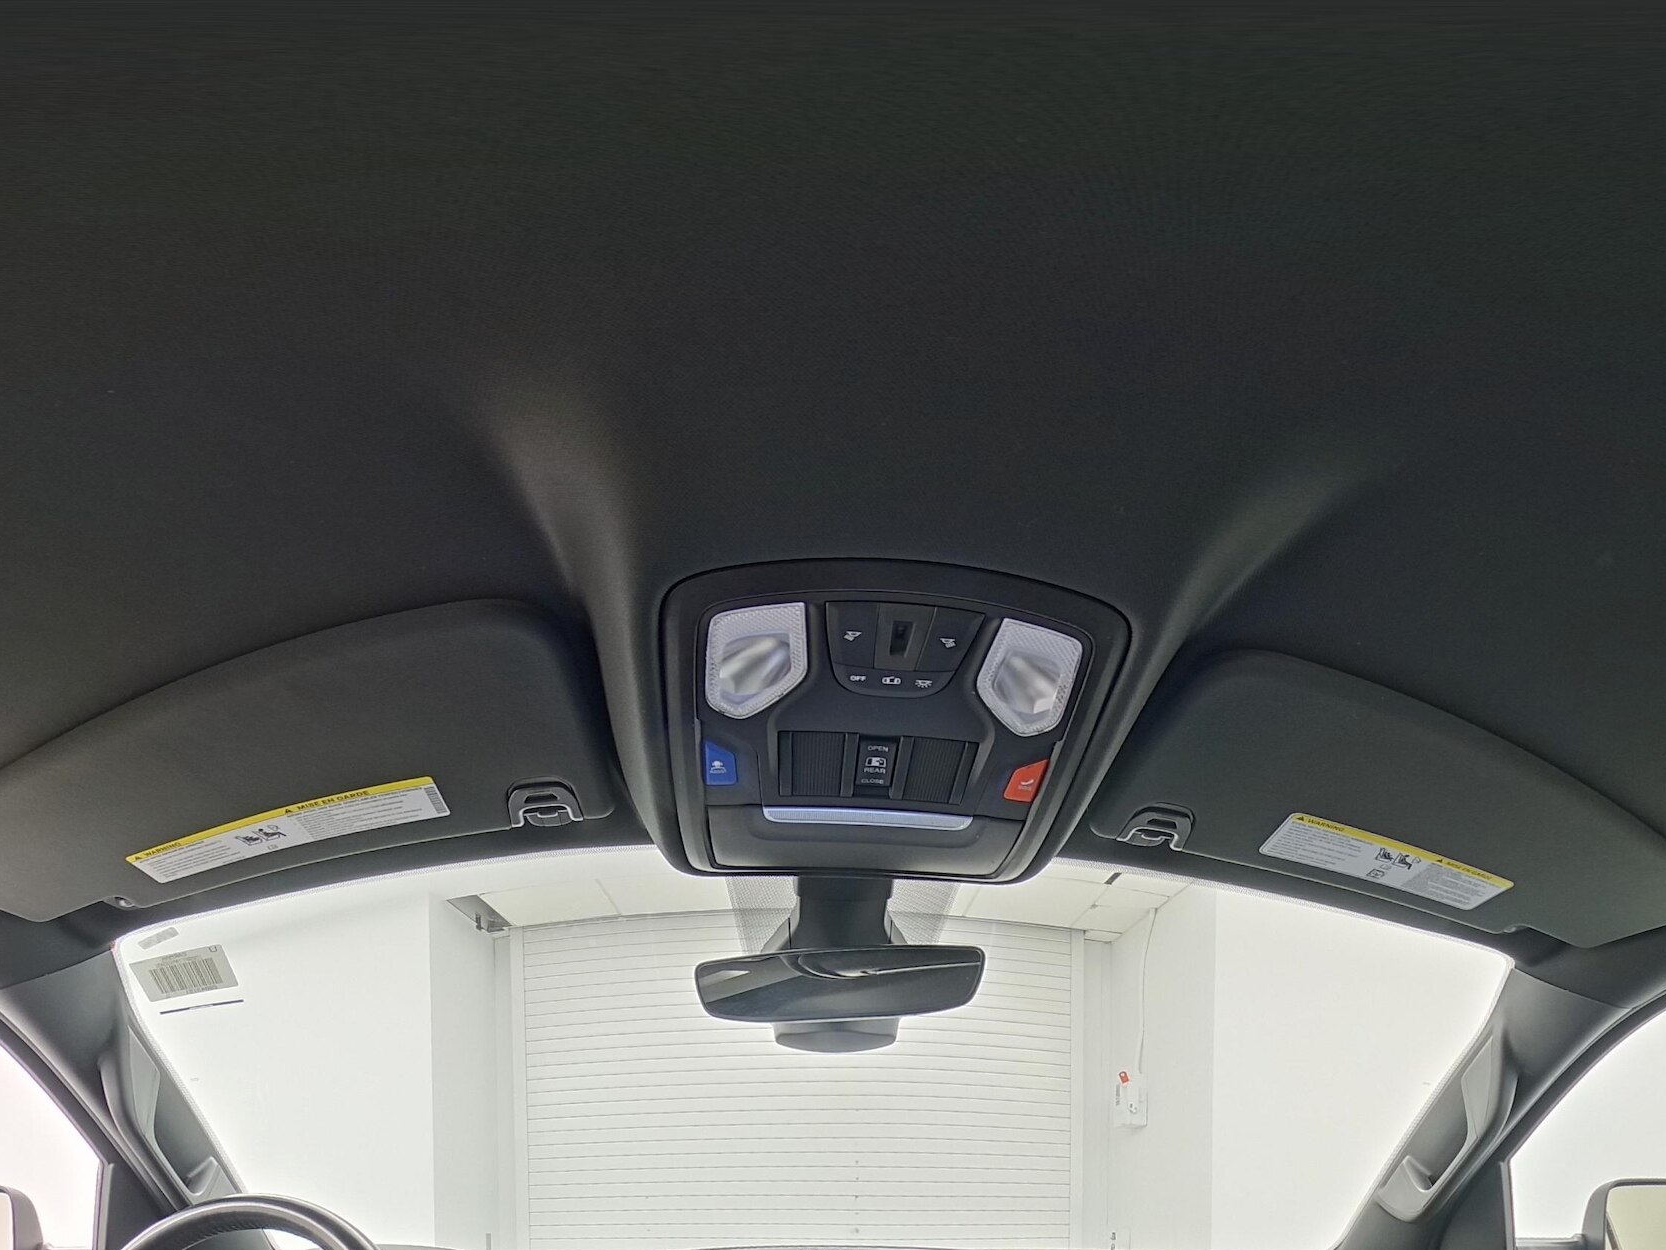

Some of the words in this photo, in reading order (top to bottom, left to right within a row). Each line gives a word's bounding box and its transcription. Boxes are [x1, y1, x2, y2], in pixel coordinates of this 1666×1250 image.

[296, 802, 318, 810] MISE
[338, 790, 370, 801] GARDE
[1307, 818, 1345, 832] WARNING
